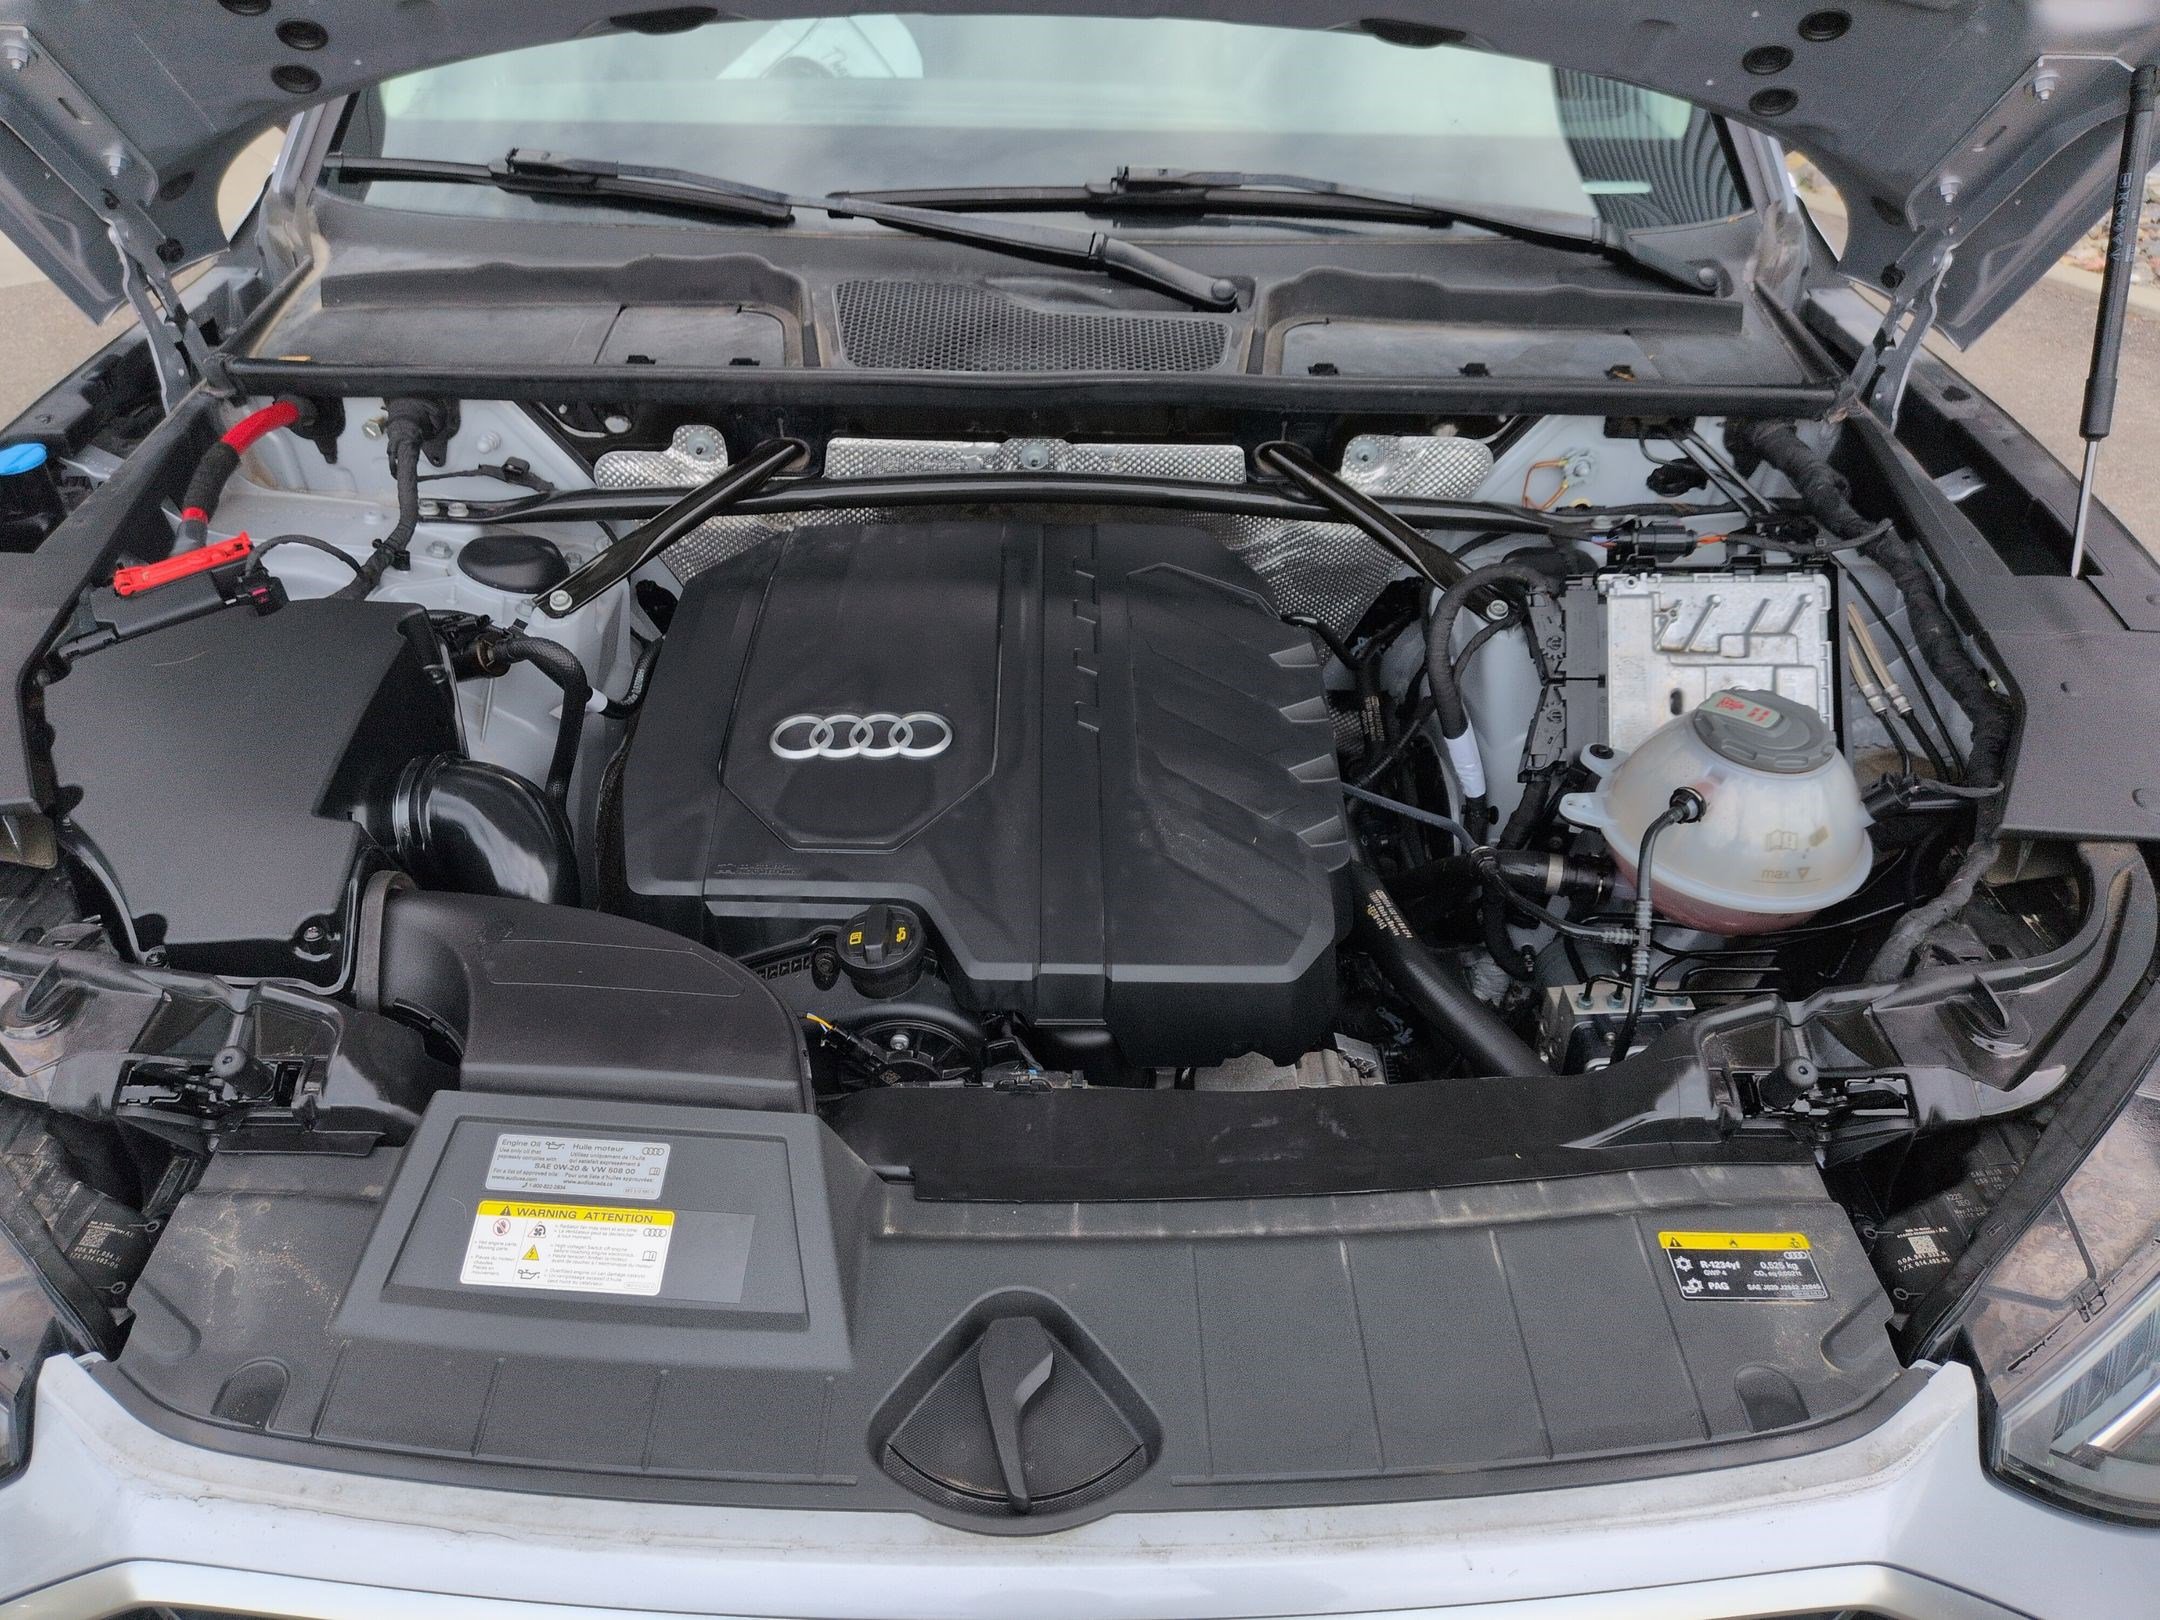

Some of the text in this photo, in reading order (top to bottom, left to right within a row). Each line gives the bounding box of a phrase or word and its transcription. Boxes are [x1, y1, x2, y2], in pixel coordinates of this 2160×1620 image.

[1761, 870, 1791, 880] max
[502, 1139, 528, 1147] Engine
[553, 1163, 580, 1172] 0W-20
[516, 1206, 654, 1224] WARNING ATTENTION
[1699, 1260, 1741, 1270] R-1234yf
[1785, 1261, 1799, 1271] kg
[1707, 1281, 1730, 1290] PAG
